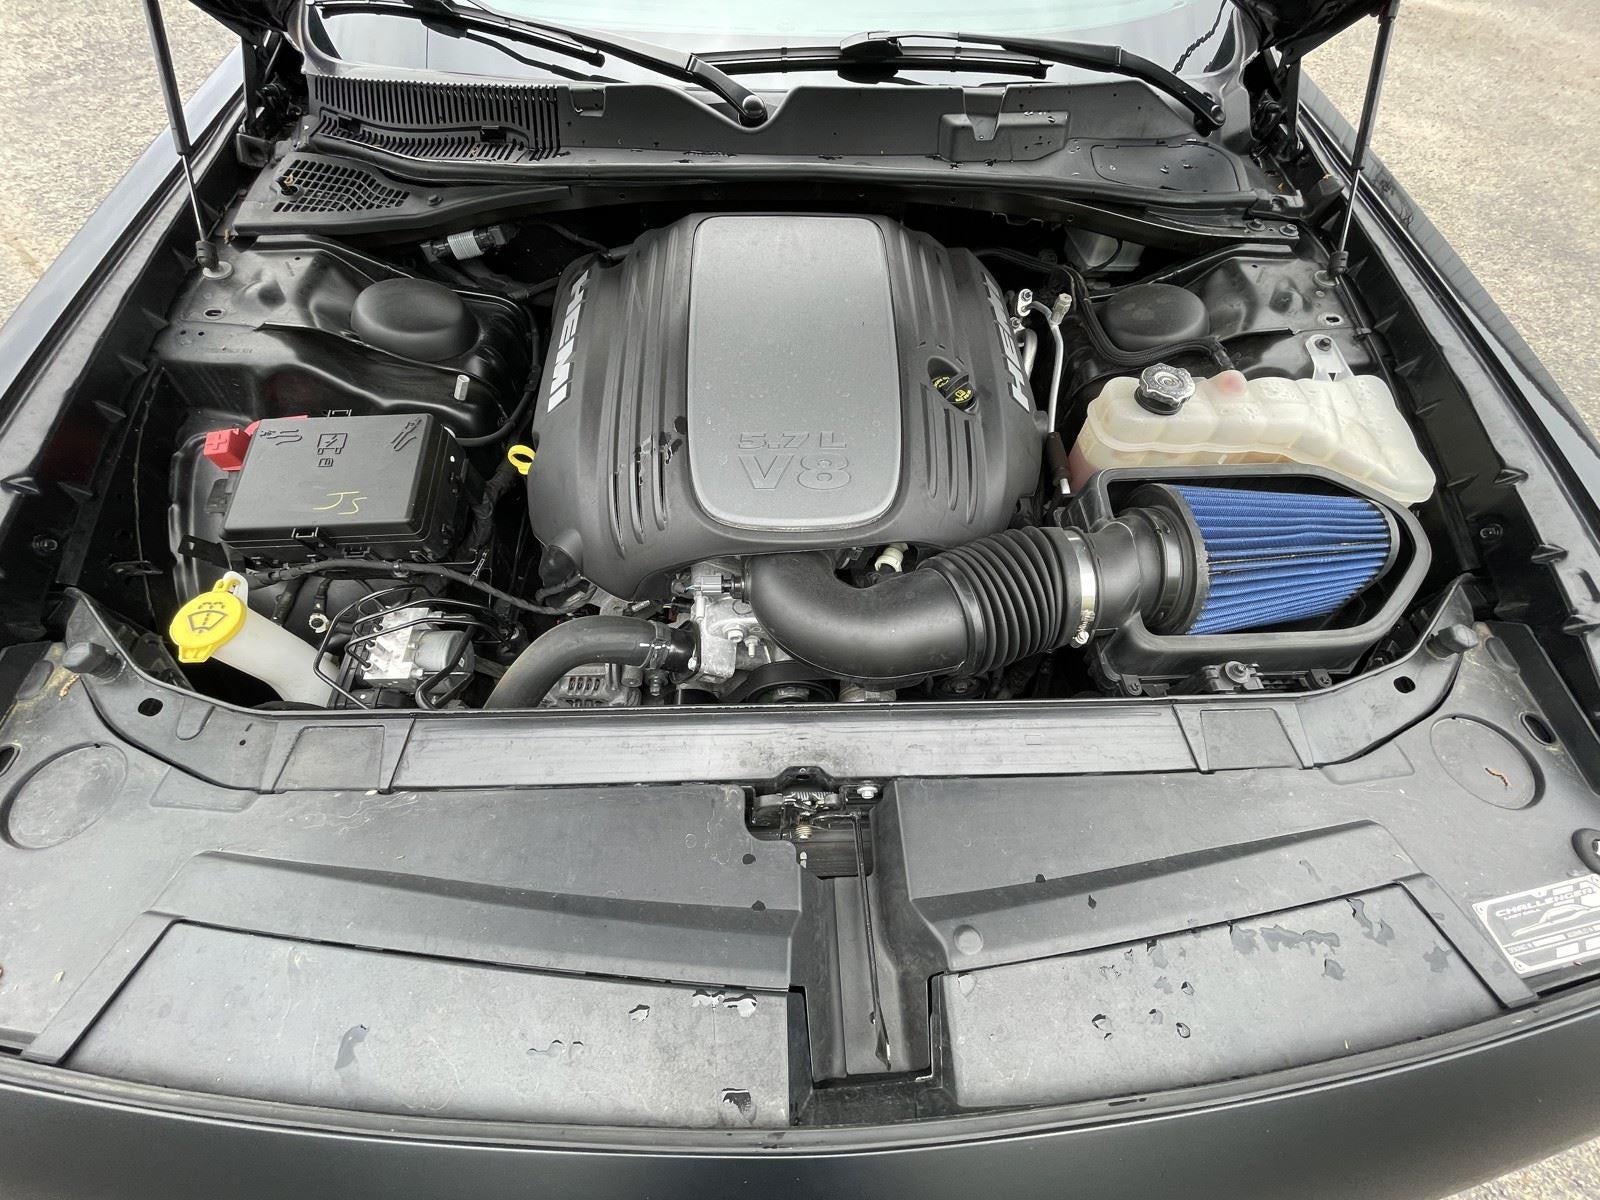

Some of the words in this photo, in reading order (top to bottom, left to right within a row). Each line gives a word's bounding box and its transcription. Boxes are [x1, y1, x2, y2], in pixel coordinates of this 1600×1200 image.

[547, 269, 589, 414] HEMI
[984, 272, 1030, 412] HEMI
[738, 454, 851, 490] V8
[1495, 886, 1596, 917] CHALLENGER
